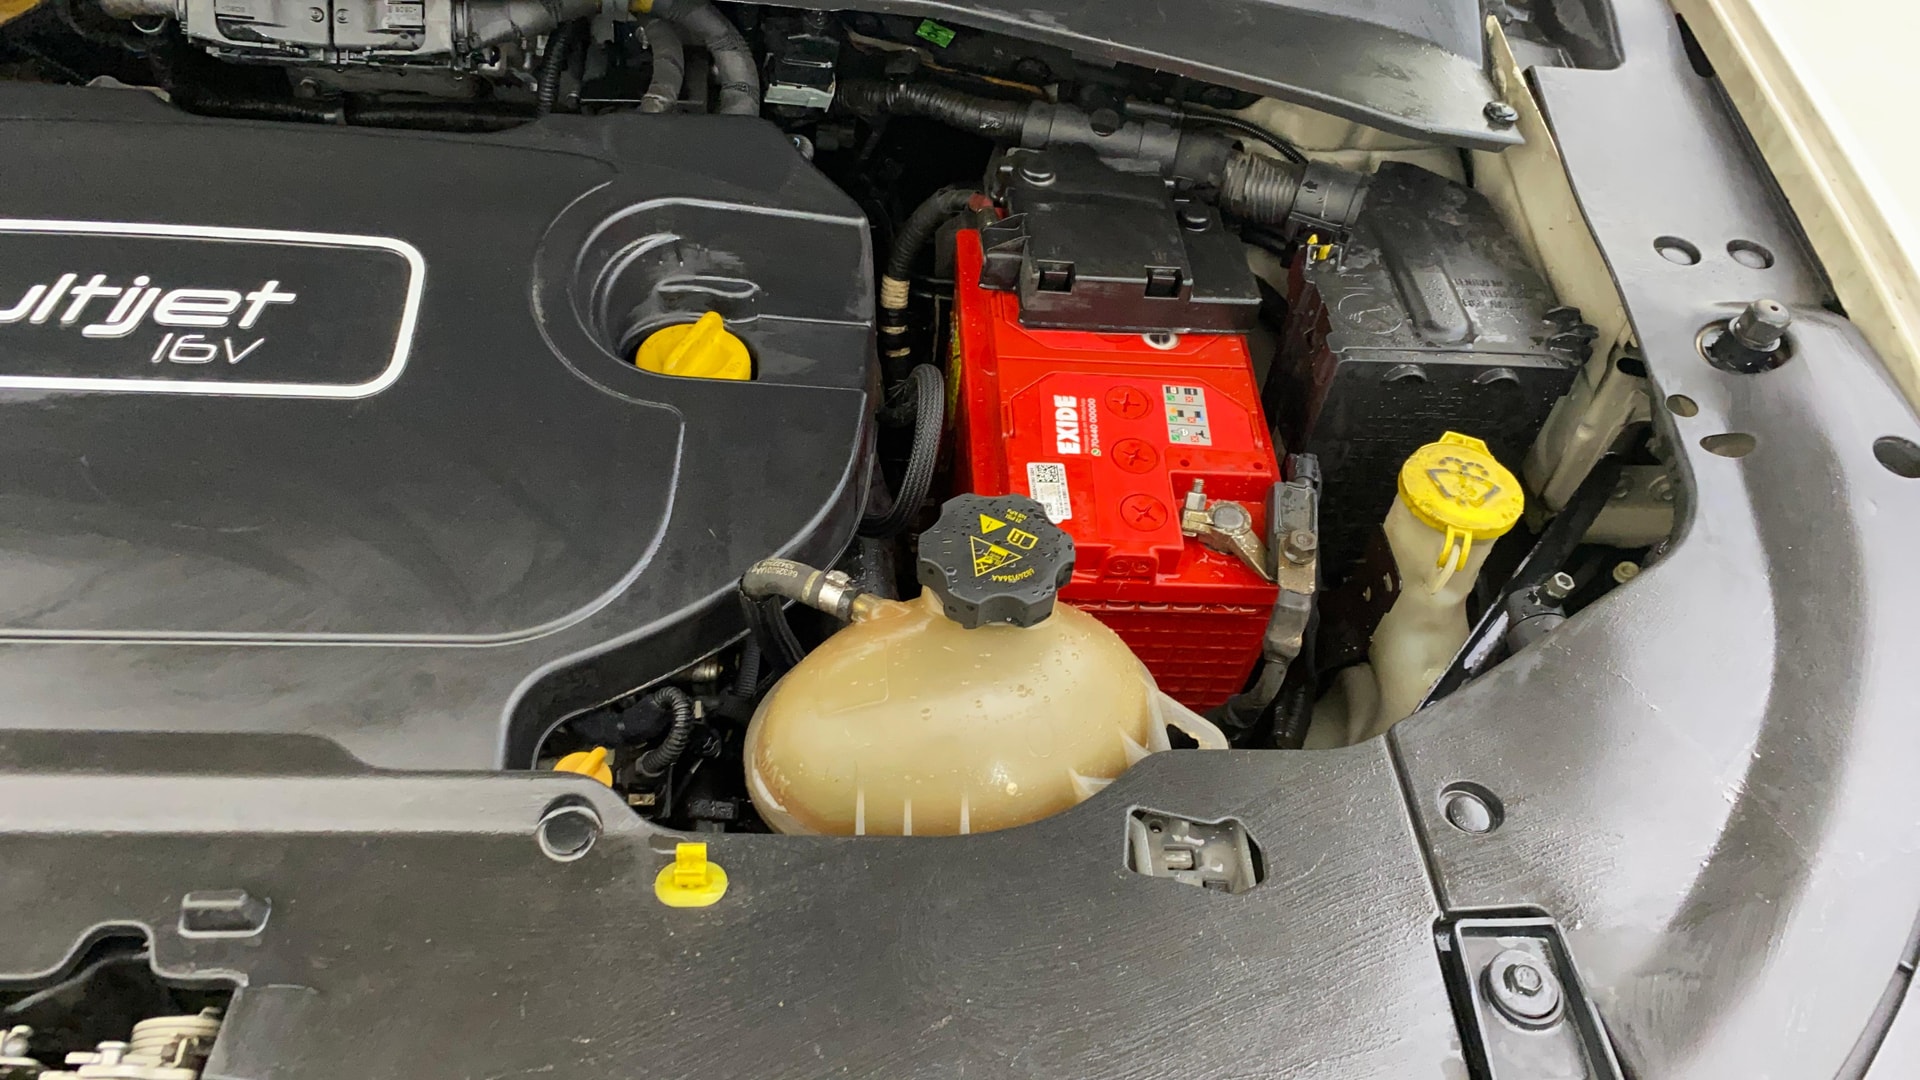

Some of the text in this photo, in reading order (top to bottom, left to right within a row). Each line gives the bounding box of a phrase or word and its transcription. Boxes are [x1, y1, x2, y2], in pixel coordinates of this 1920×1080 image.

[1053, 395, 1081, 454] EXIDE
[1088, 398, 1099, 448] 70440 00000
